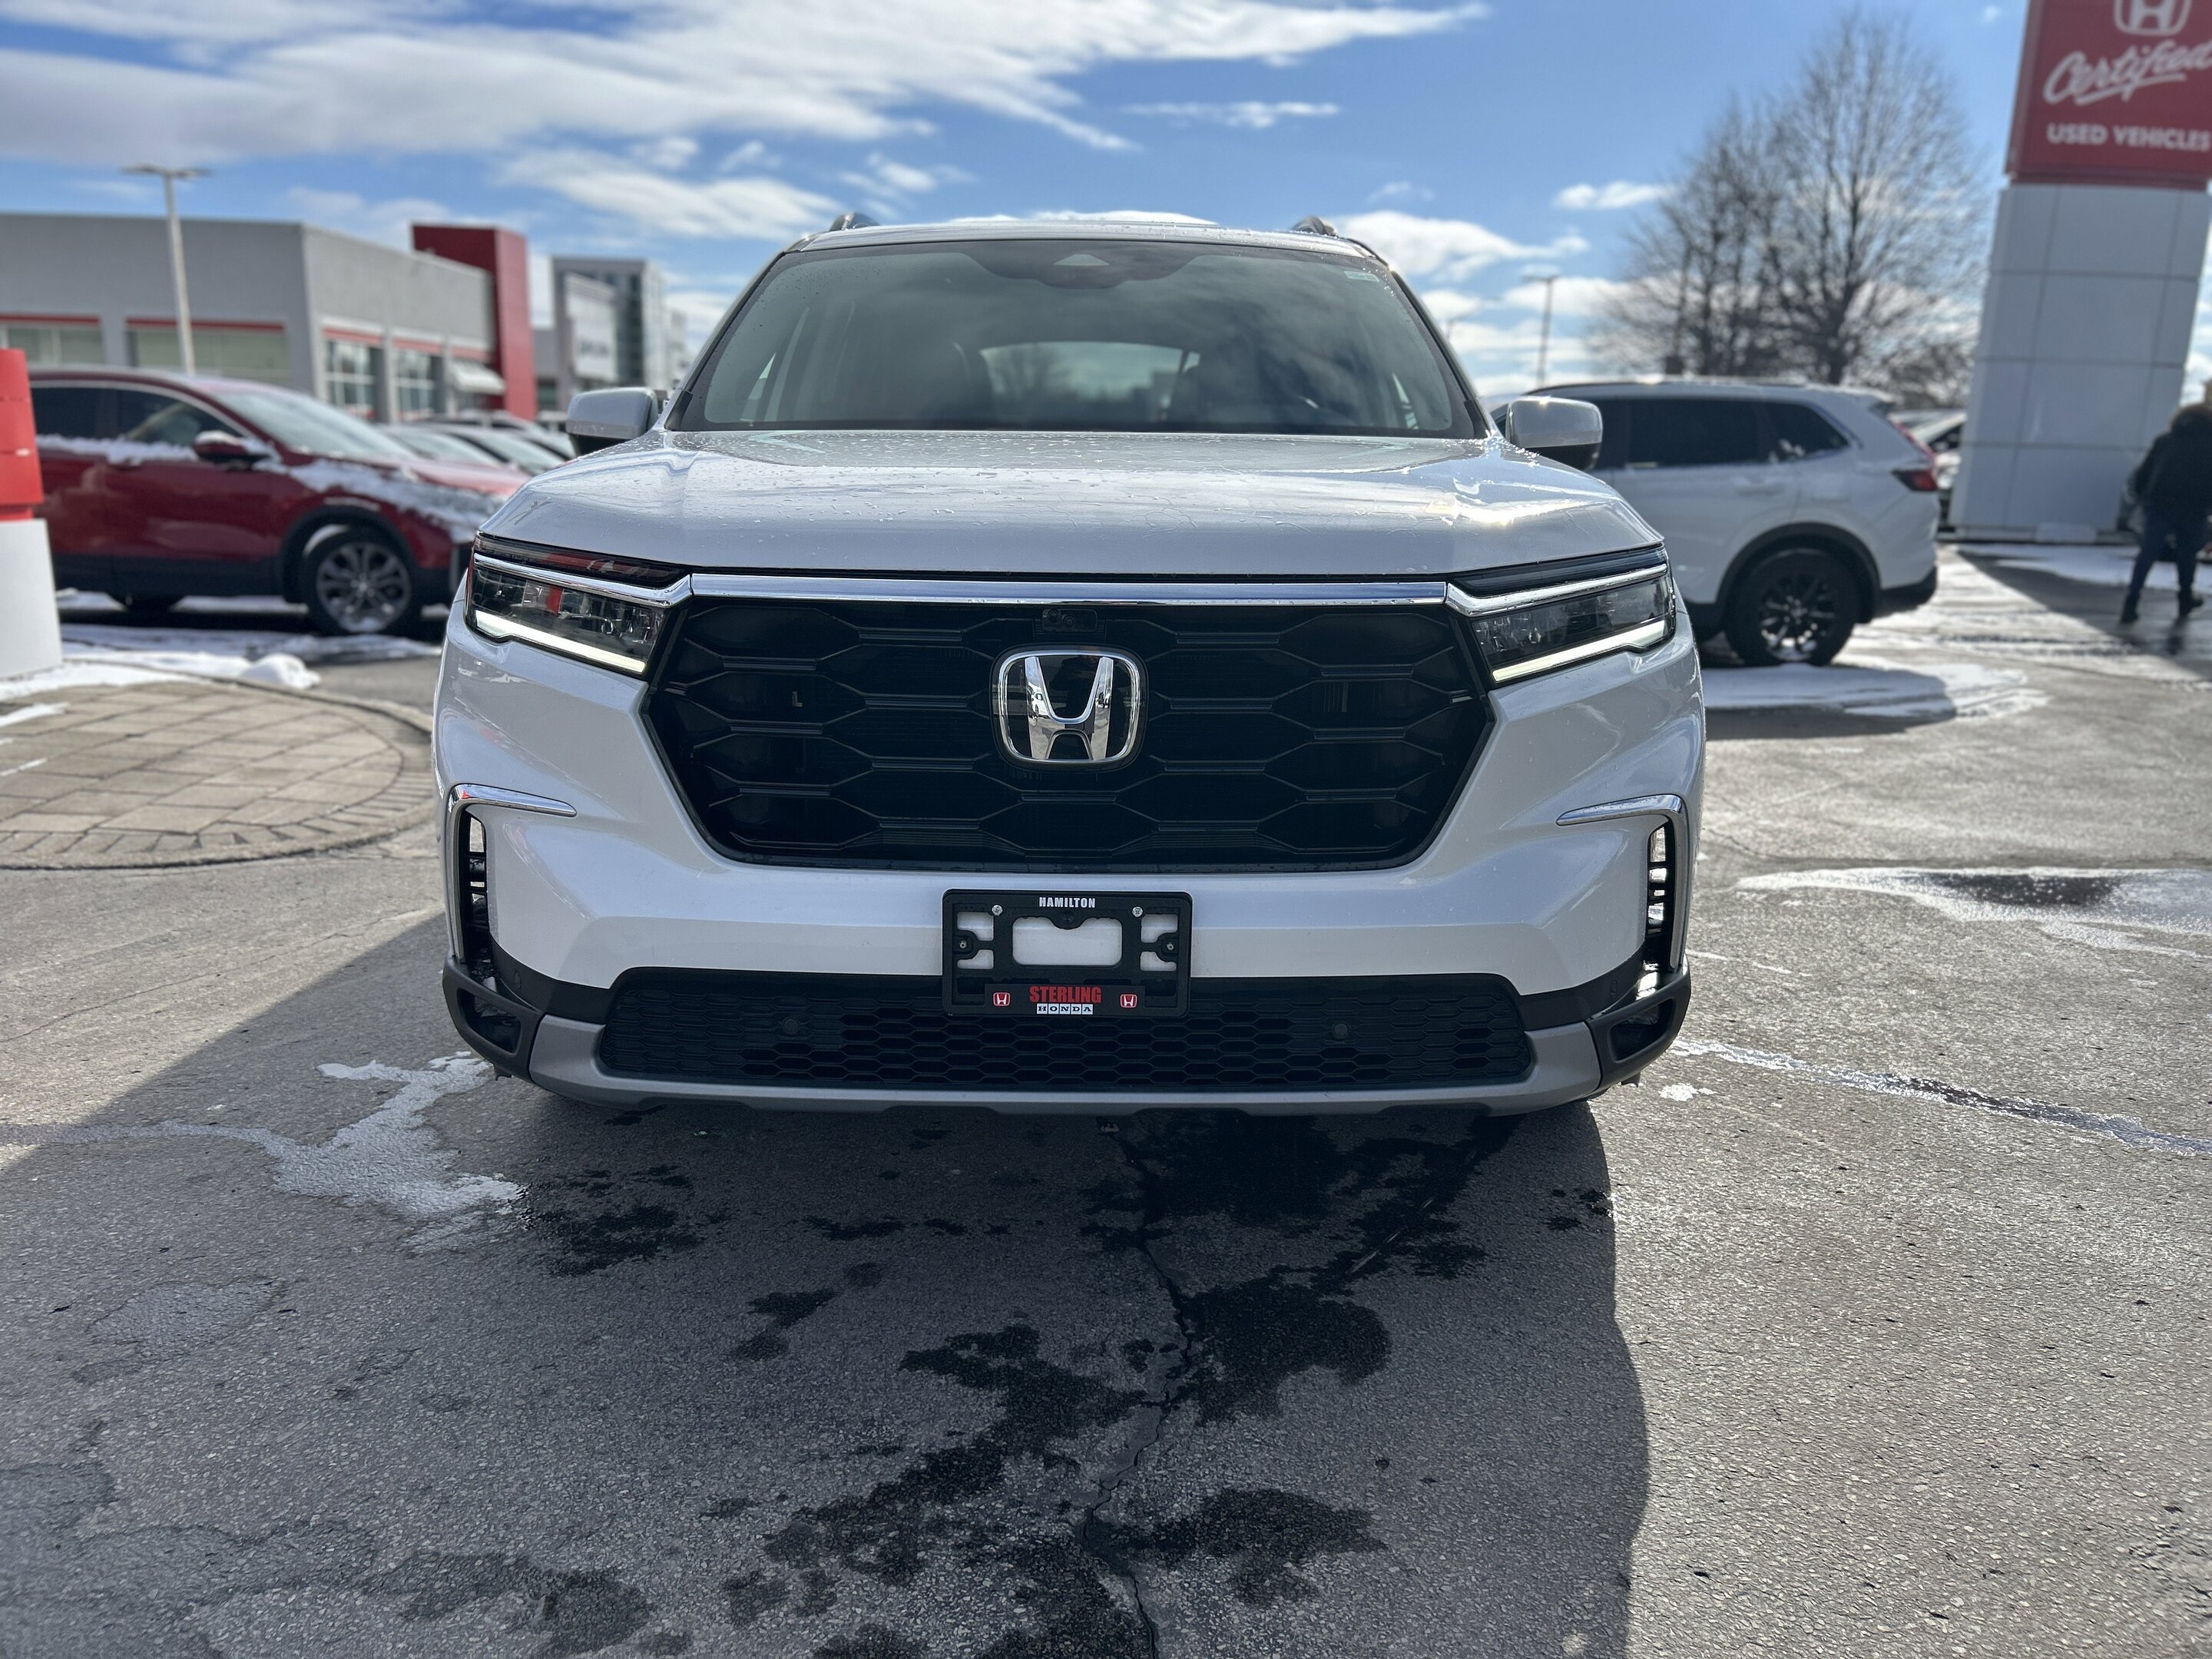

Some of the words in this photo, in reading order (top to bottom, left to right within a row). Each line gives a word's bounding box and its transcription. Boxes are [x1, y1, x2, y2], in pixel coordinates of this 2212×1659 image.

[2047, 124, 2107, 144] USED
[2113, 125, 2211, 152] VEHICLES
[1038, 896, 1096, 909] HAMILTON
[1029, 985, 1102, 1004] STERLING
